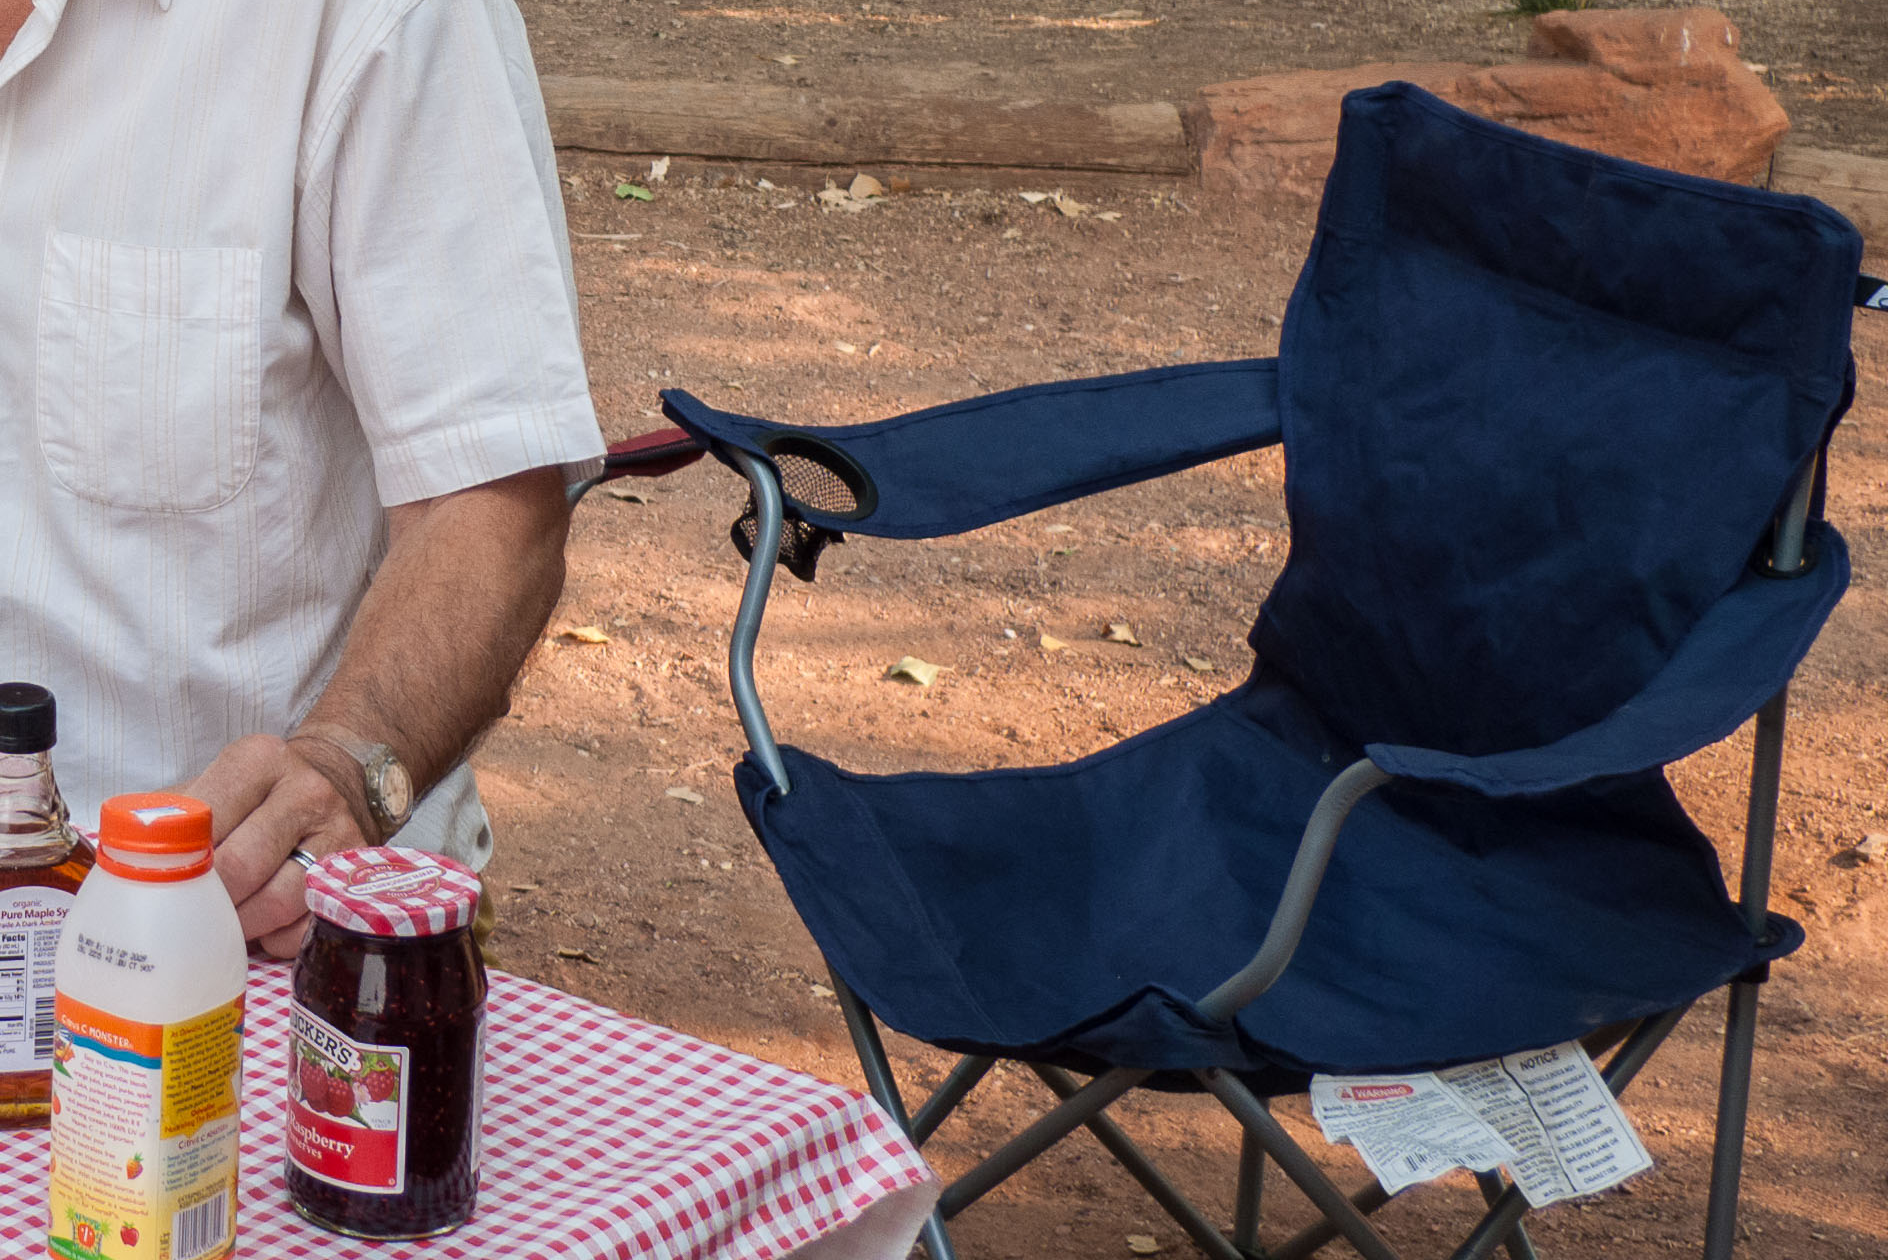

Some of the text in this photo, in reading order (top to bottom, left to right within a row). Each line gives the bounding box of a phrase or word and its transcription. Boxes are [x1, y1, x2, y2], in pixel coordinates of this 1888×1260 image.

[13, 899, 42, 909] organic
[1, 910, 23, 920] Pure
[24, 908, 55, 920] Maple
[2, 933, 26, 942] Facts
[81, 1023, 88, 1034] C
[88, 1026, 130, 1048] MONSTER
[1519, 1048, 1560, 1072] NOTICE
[1356, 1085, 1407, 1098] WARNING
[290, 1110, 355, 1160] Raspberry
